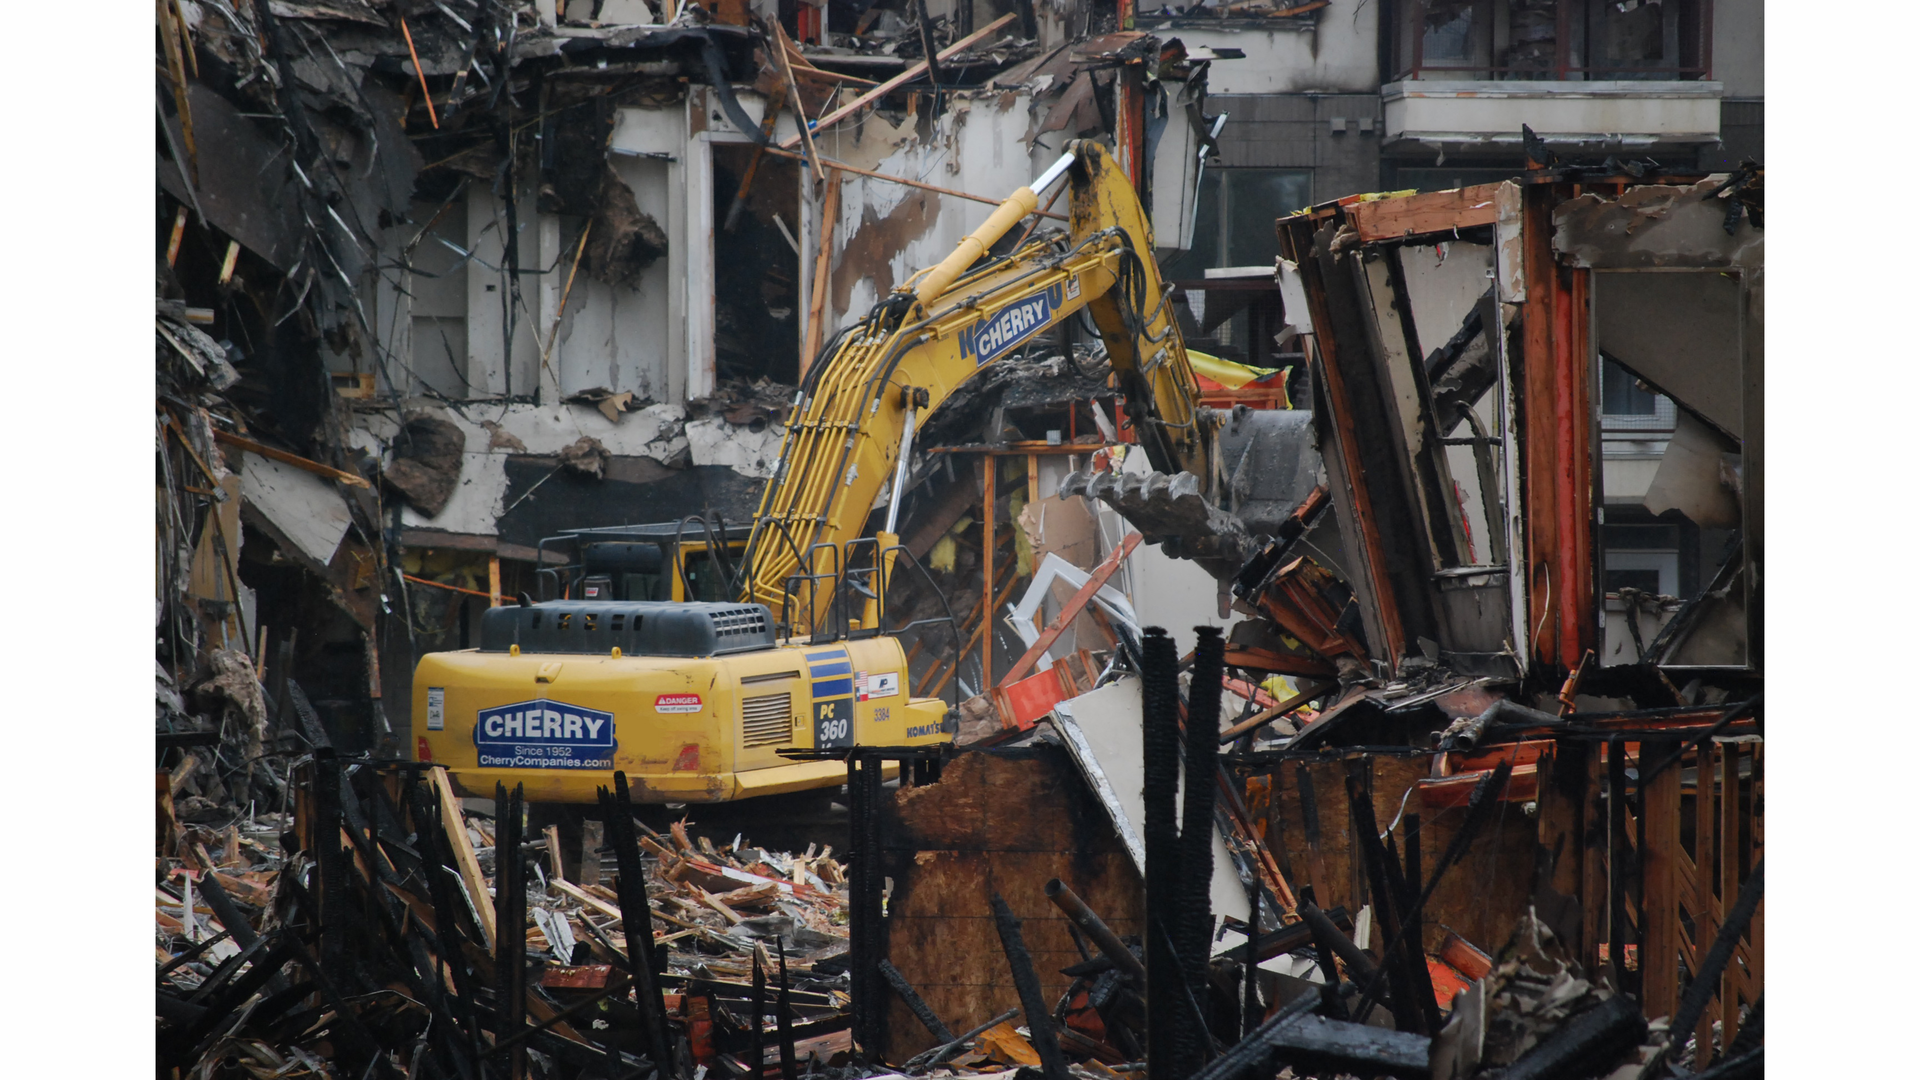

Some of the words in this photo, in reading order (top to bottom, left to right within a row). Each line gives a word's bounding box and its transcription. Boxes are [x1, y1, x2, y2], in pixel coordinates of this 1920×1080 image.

[979, 299, 1044, 356] CHERRY
[820, 703, 834, 719] PC
[484, 709, 605, 739] CHERRY
[820, 718, 848, 741] 360
[515, 745, 543, 756] Since
[546, 747, 572, 757] 1952
[480, 755, 612, 768] CherryCompanies.com
